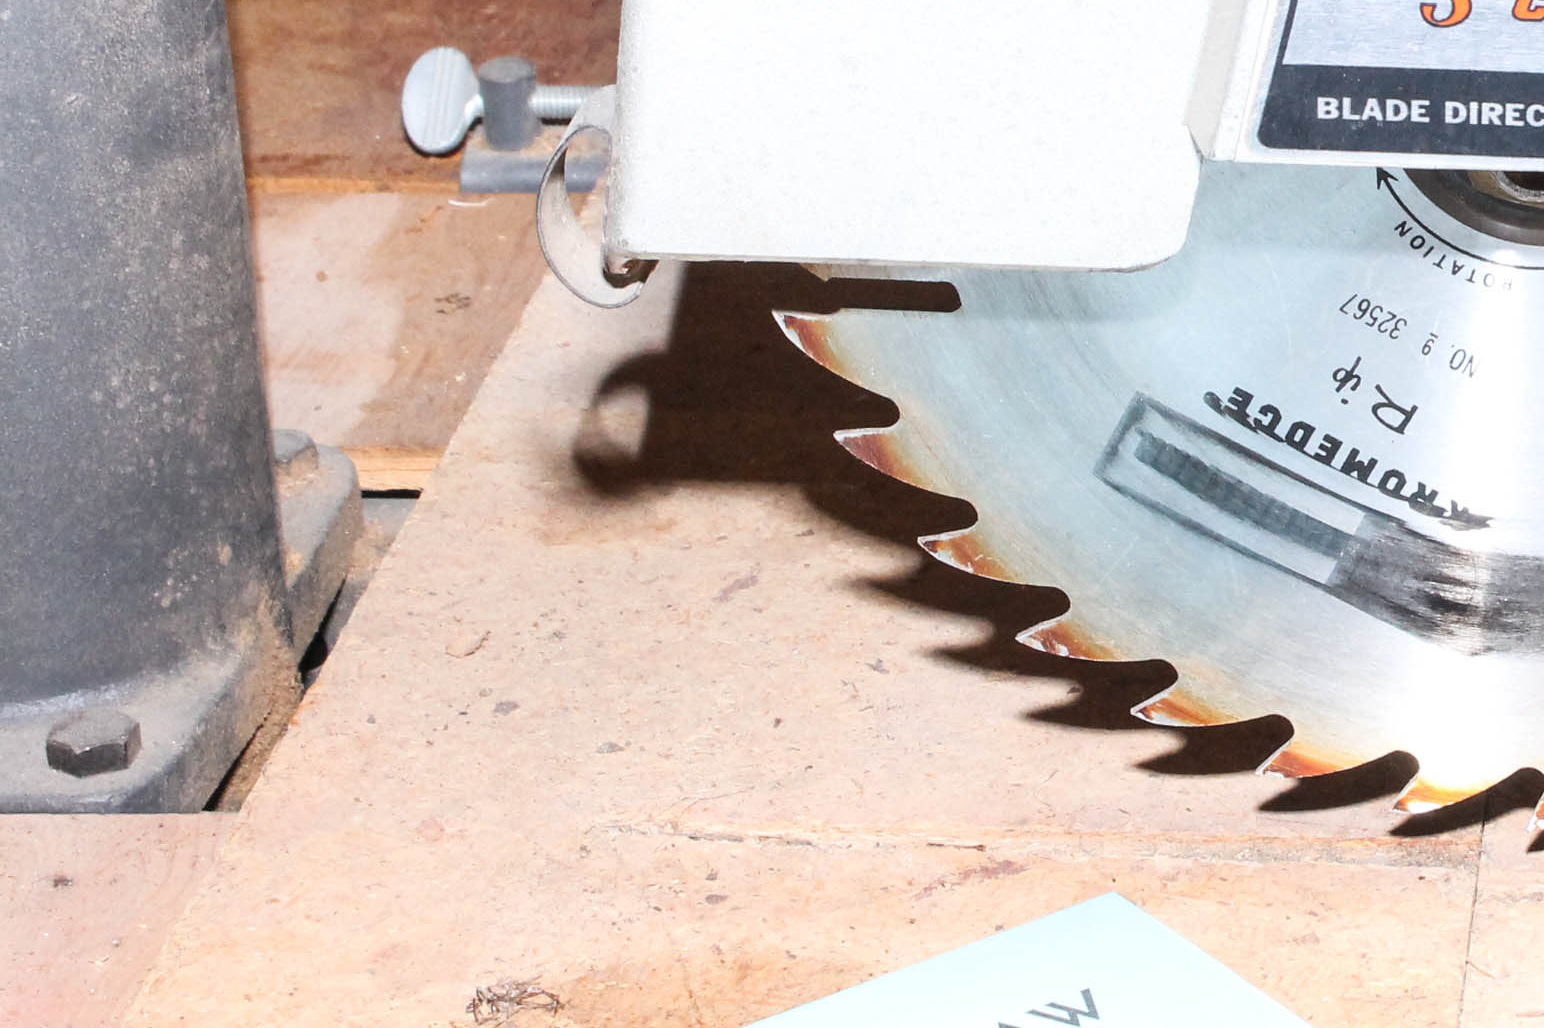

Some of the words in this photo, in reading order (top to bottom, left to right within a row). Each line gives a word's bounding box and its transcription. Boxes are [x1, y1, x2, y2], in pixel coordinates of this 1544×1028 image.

[1315, 96, 1431, 125] BLADE
[1394, 220, 1513, 292] ROTATION
[1338, 293, 1408, 340] 32567
[1331, 355, 1419, 436] Rip
